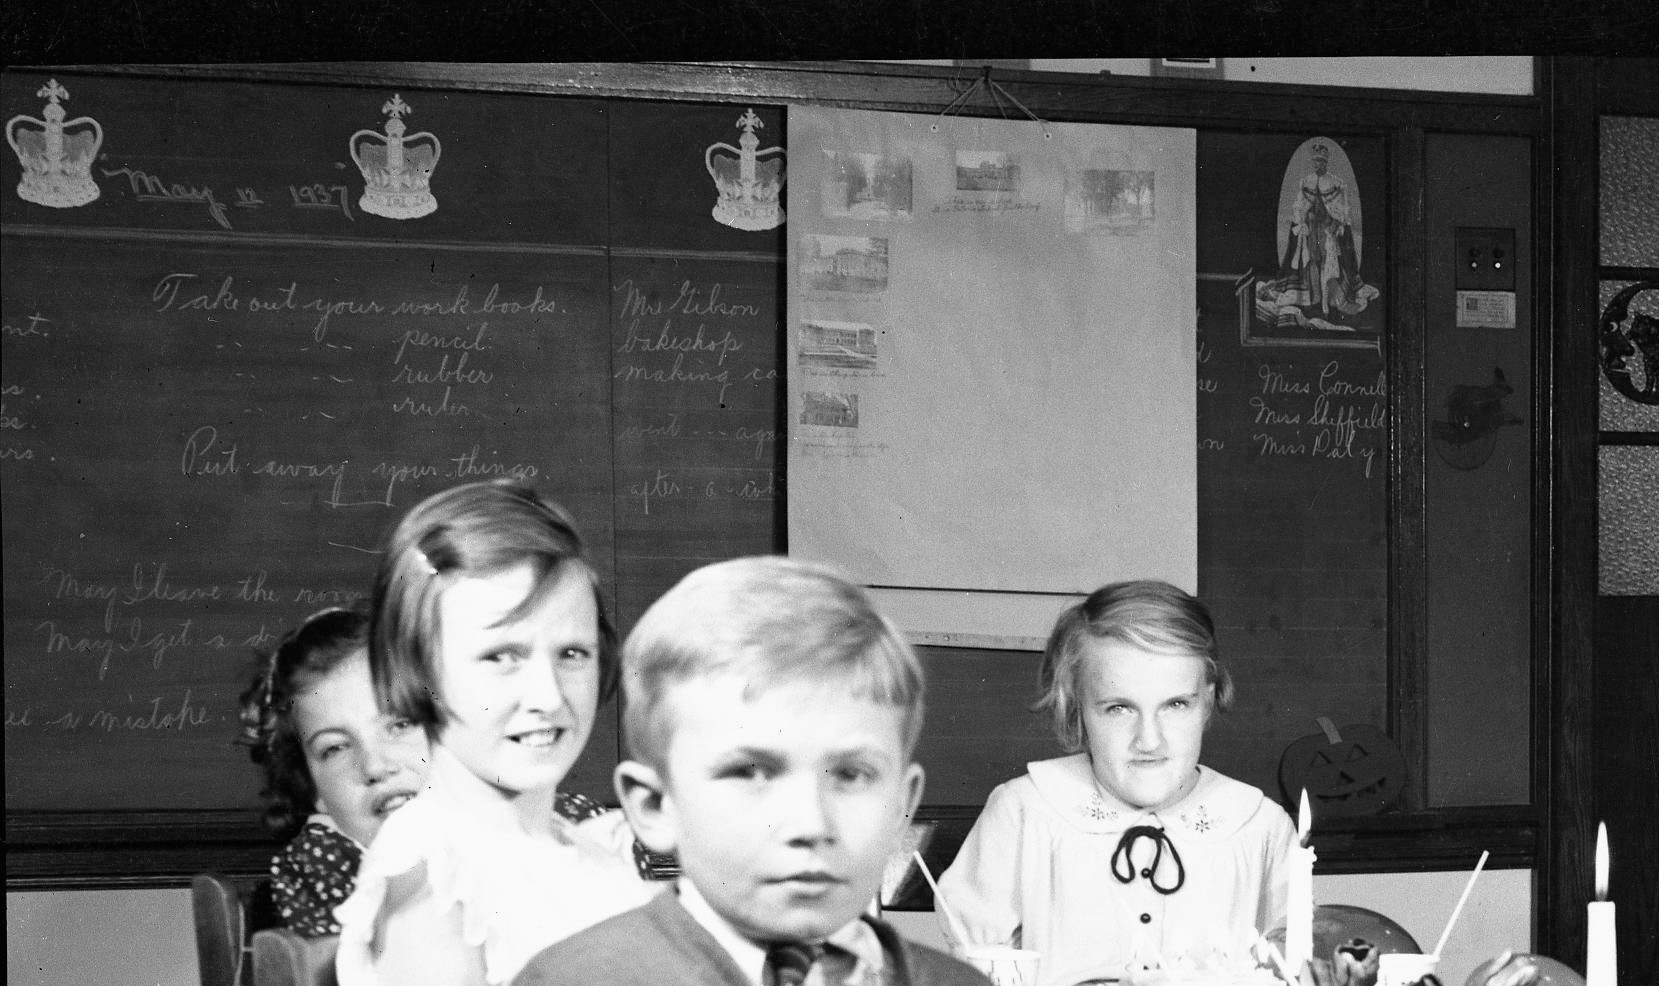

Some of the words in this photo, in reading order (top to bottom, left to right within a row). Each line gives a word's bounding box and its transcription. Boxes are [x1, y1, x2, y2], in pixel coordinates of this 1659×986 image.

[101, 167, 233, 230] May
[290, 184, 354, 222] 1937
[152, 273, 238, 313] Take
[249, 281, 297, 313] out
[302, 297, 385, 342] your
[617, 318, 744, 366] bakeshop
[392, 352, 494, 384] rubber
[613, 353, 733, 404] making
[1258, 364, 1310, 394] Miss
[1249, 396, 1301, 424] Miss
[181, 424, 239, 477] Put
[253, 459, 347, 508] away
[372, 462, 437, 507] your
[1253, 431, 1306, 457] Miss
[38, 568, 119, 634] May
[238, 569, 280, 603] the
[34, 619, 116, 682] May
[143, 618, 194, 671] get
